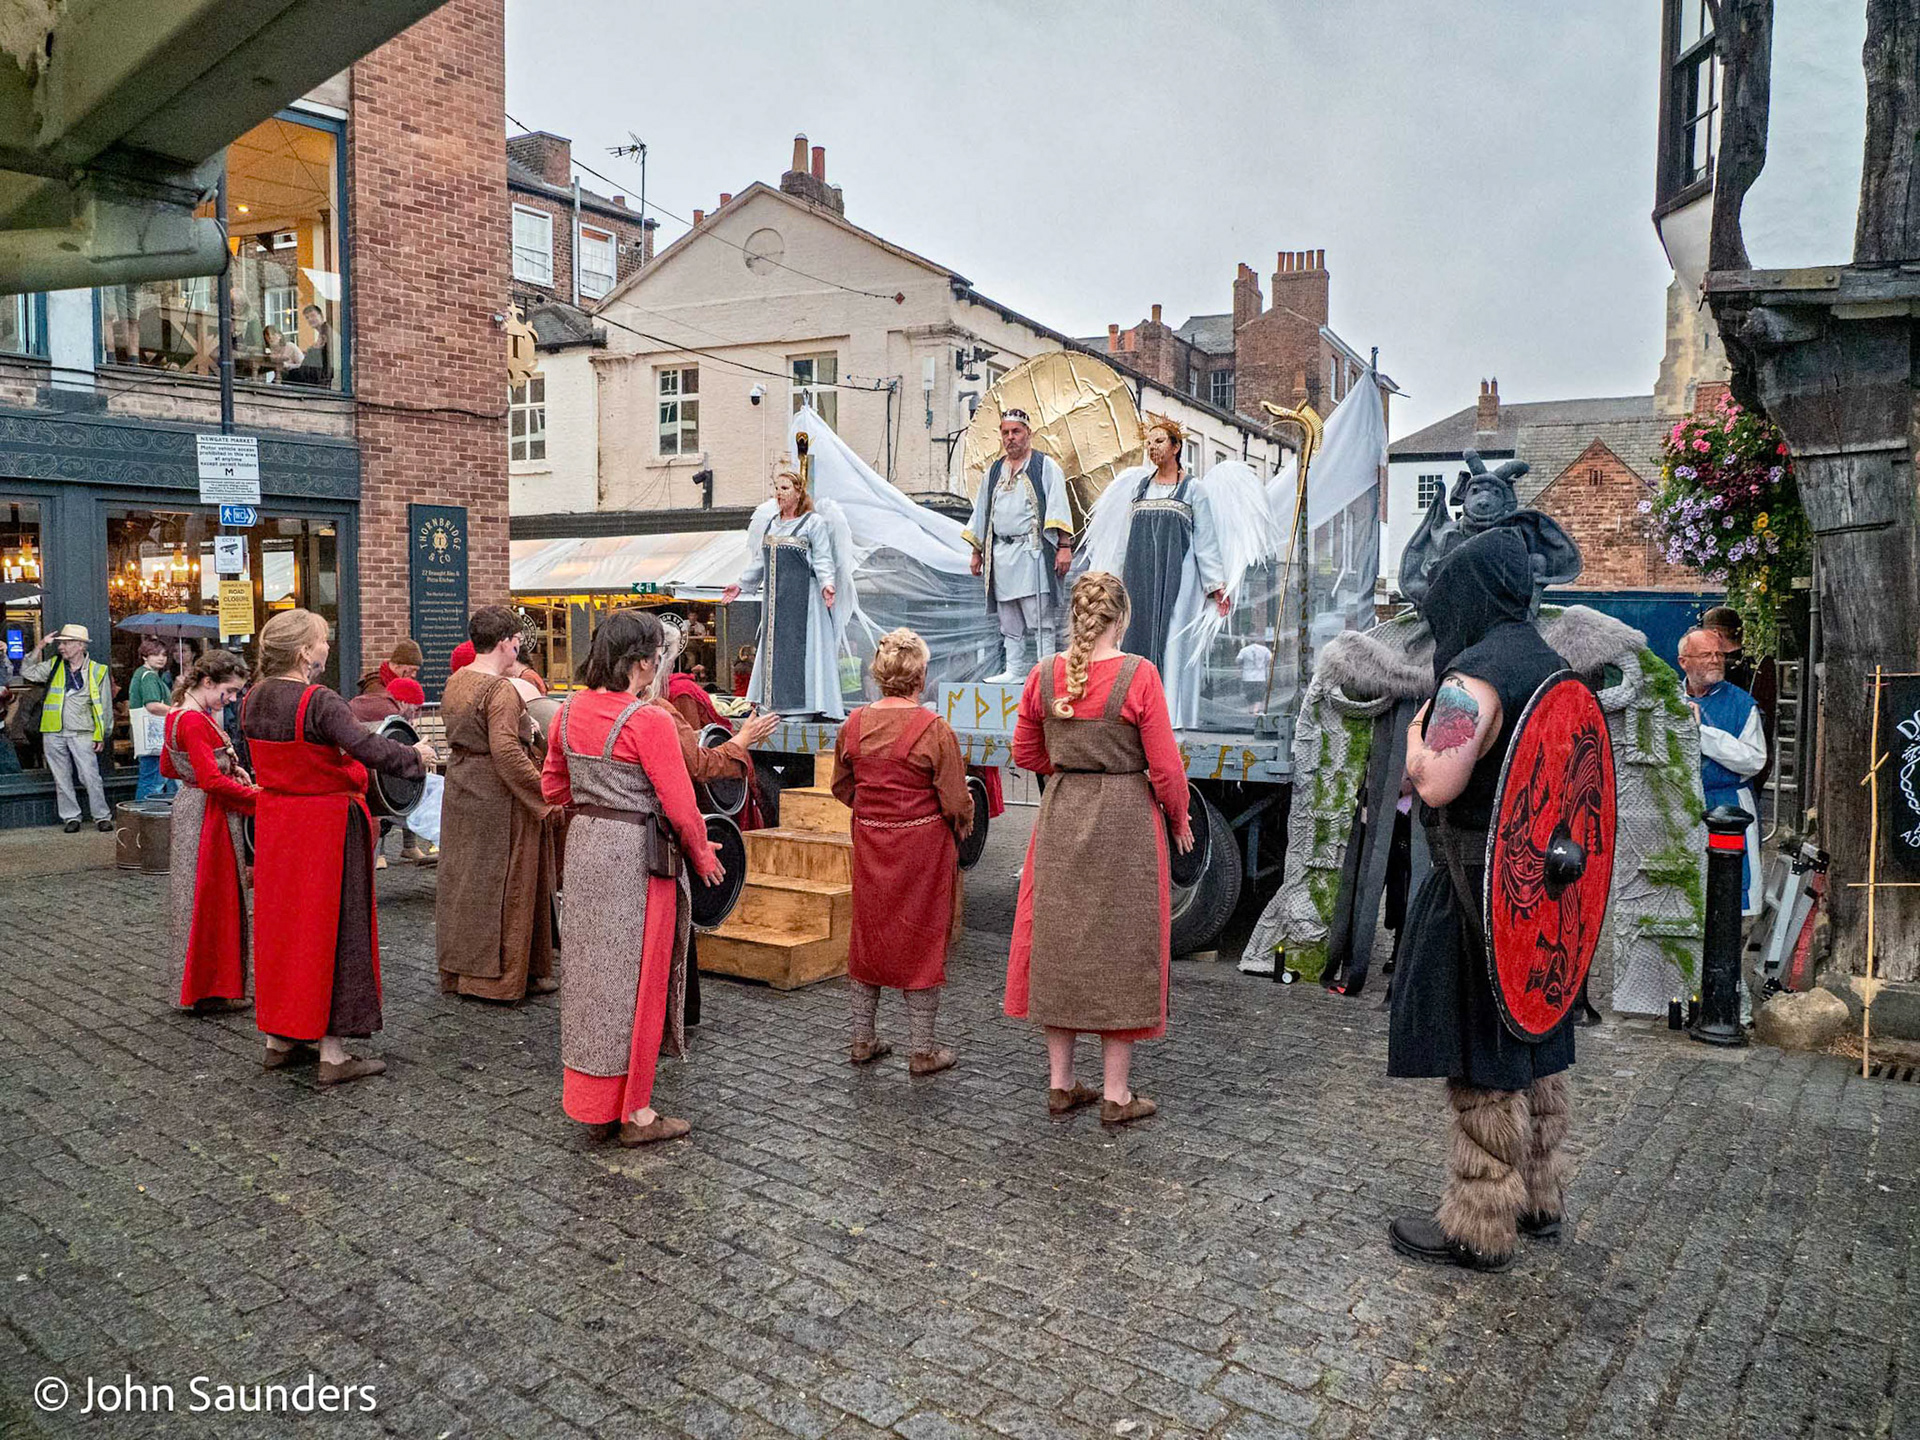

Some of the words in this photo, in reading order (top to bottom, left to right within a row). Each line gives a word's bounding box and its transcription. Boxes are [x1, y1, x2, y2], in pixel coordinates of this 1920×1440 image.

[225, 468, 234, 476] M
[419, 517, 462, 551] THORNBRIDGE
[439, 553, 451, 564] CO
